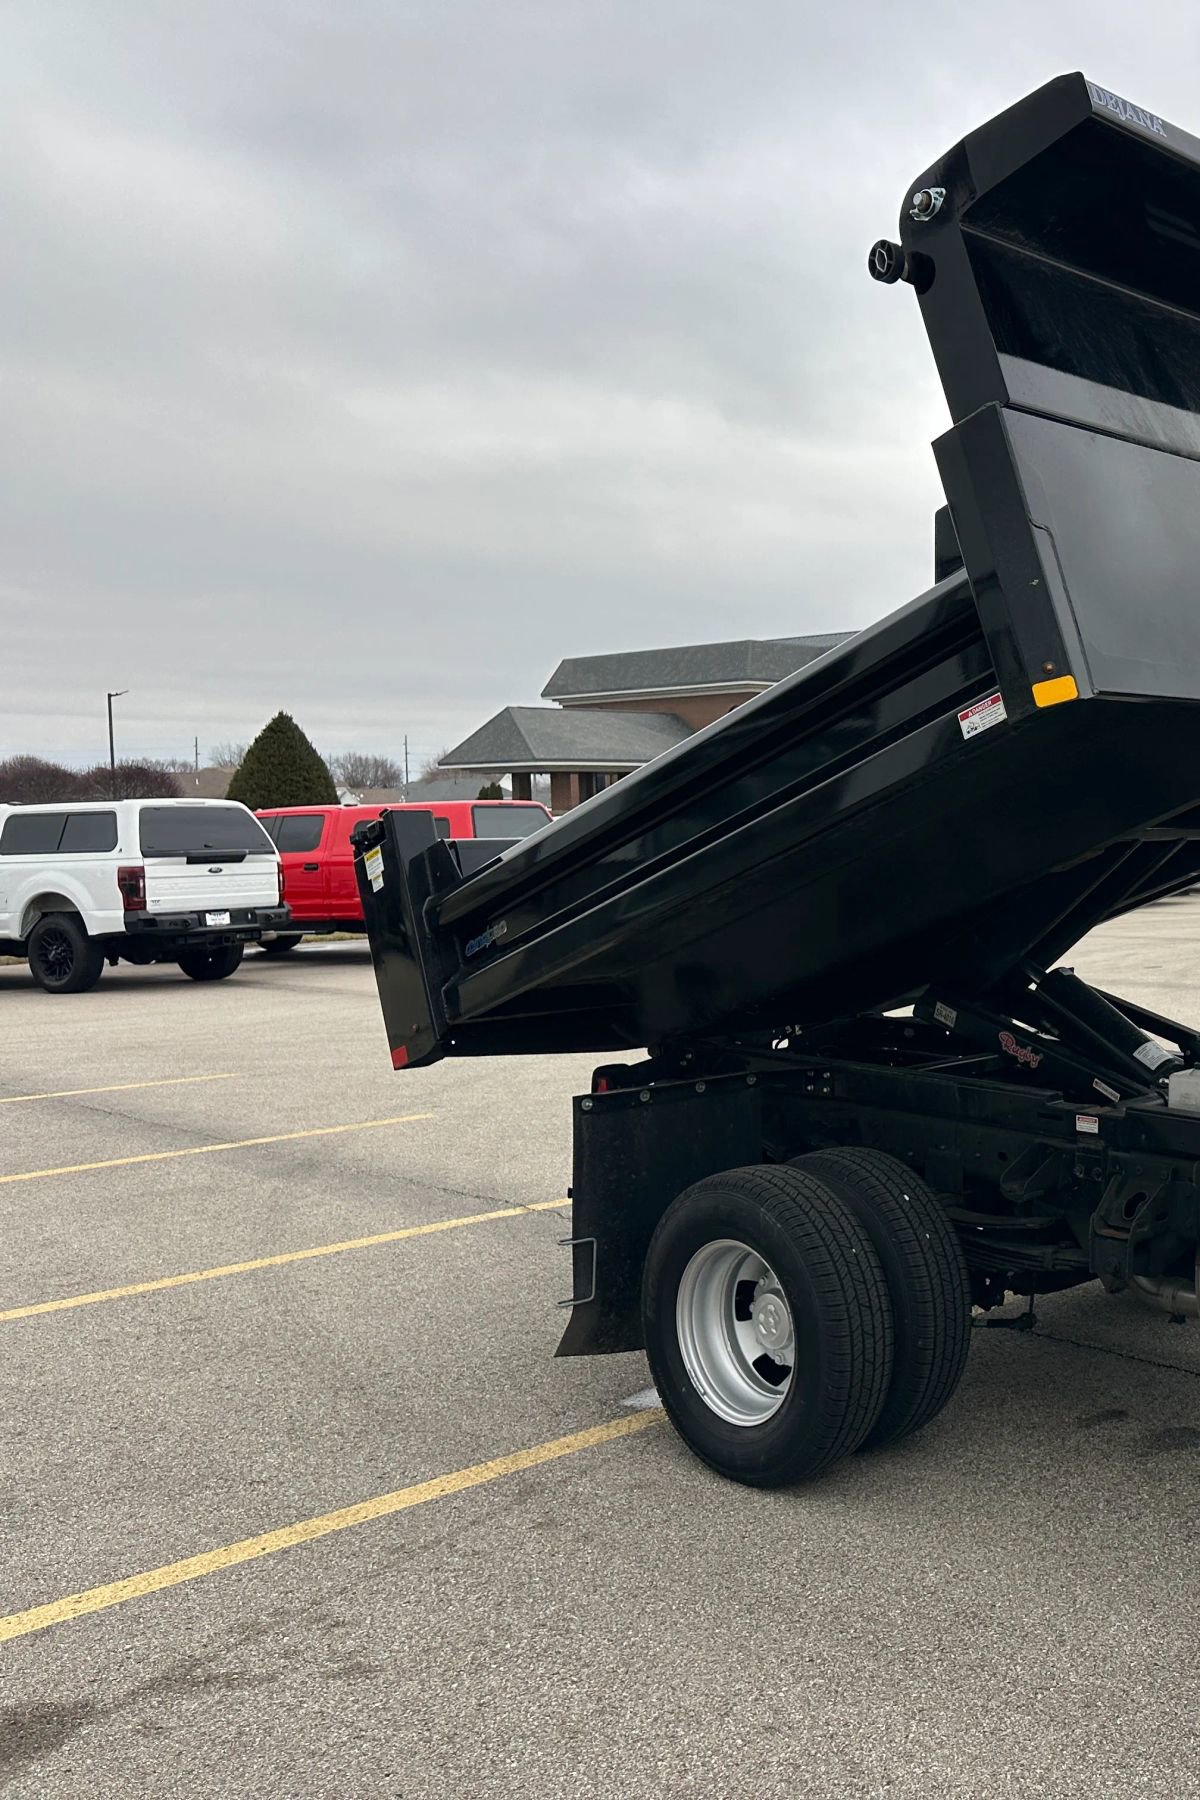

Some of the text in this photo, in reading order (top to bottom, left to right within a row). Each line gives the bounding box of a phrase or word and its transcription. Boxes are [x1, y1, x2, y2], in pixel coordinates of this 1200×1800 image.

[1088, 82, 1167, 138] DEJANA
[971, 700, 992, 715] DANGER
[999, 1031, 1041, 1069] Rugby
